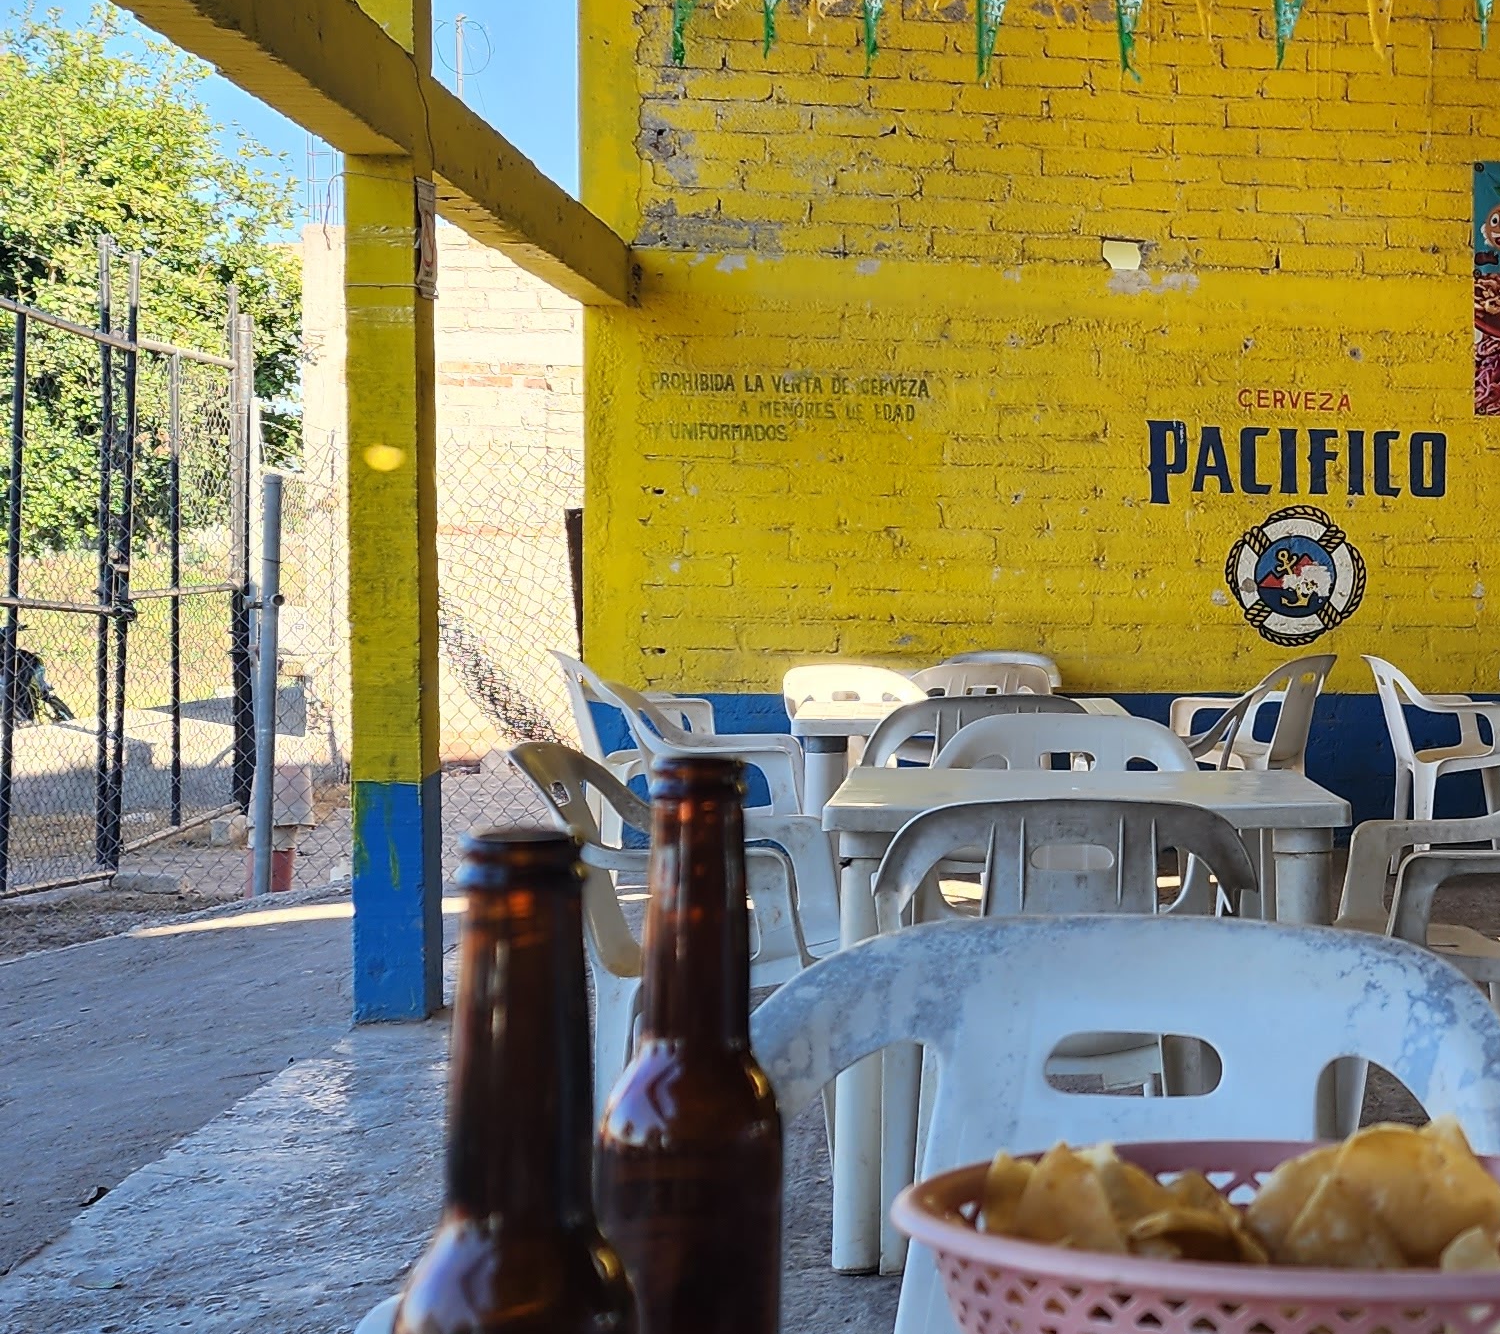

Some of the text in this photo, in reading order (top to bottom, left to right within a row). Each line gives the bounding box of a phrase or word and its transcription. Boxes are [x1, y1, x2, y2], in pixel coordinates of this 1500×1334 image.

[651, 371, 930, 399] PROHIBIDA LA VENTA DE CERVEZA
[1238, 388, 1352, 411] CERVEZA
[875, 403, 915, 423] EDAD
[1145, 419, 1448, 504] PACIFICO
